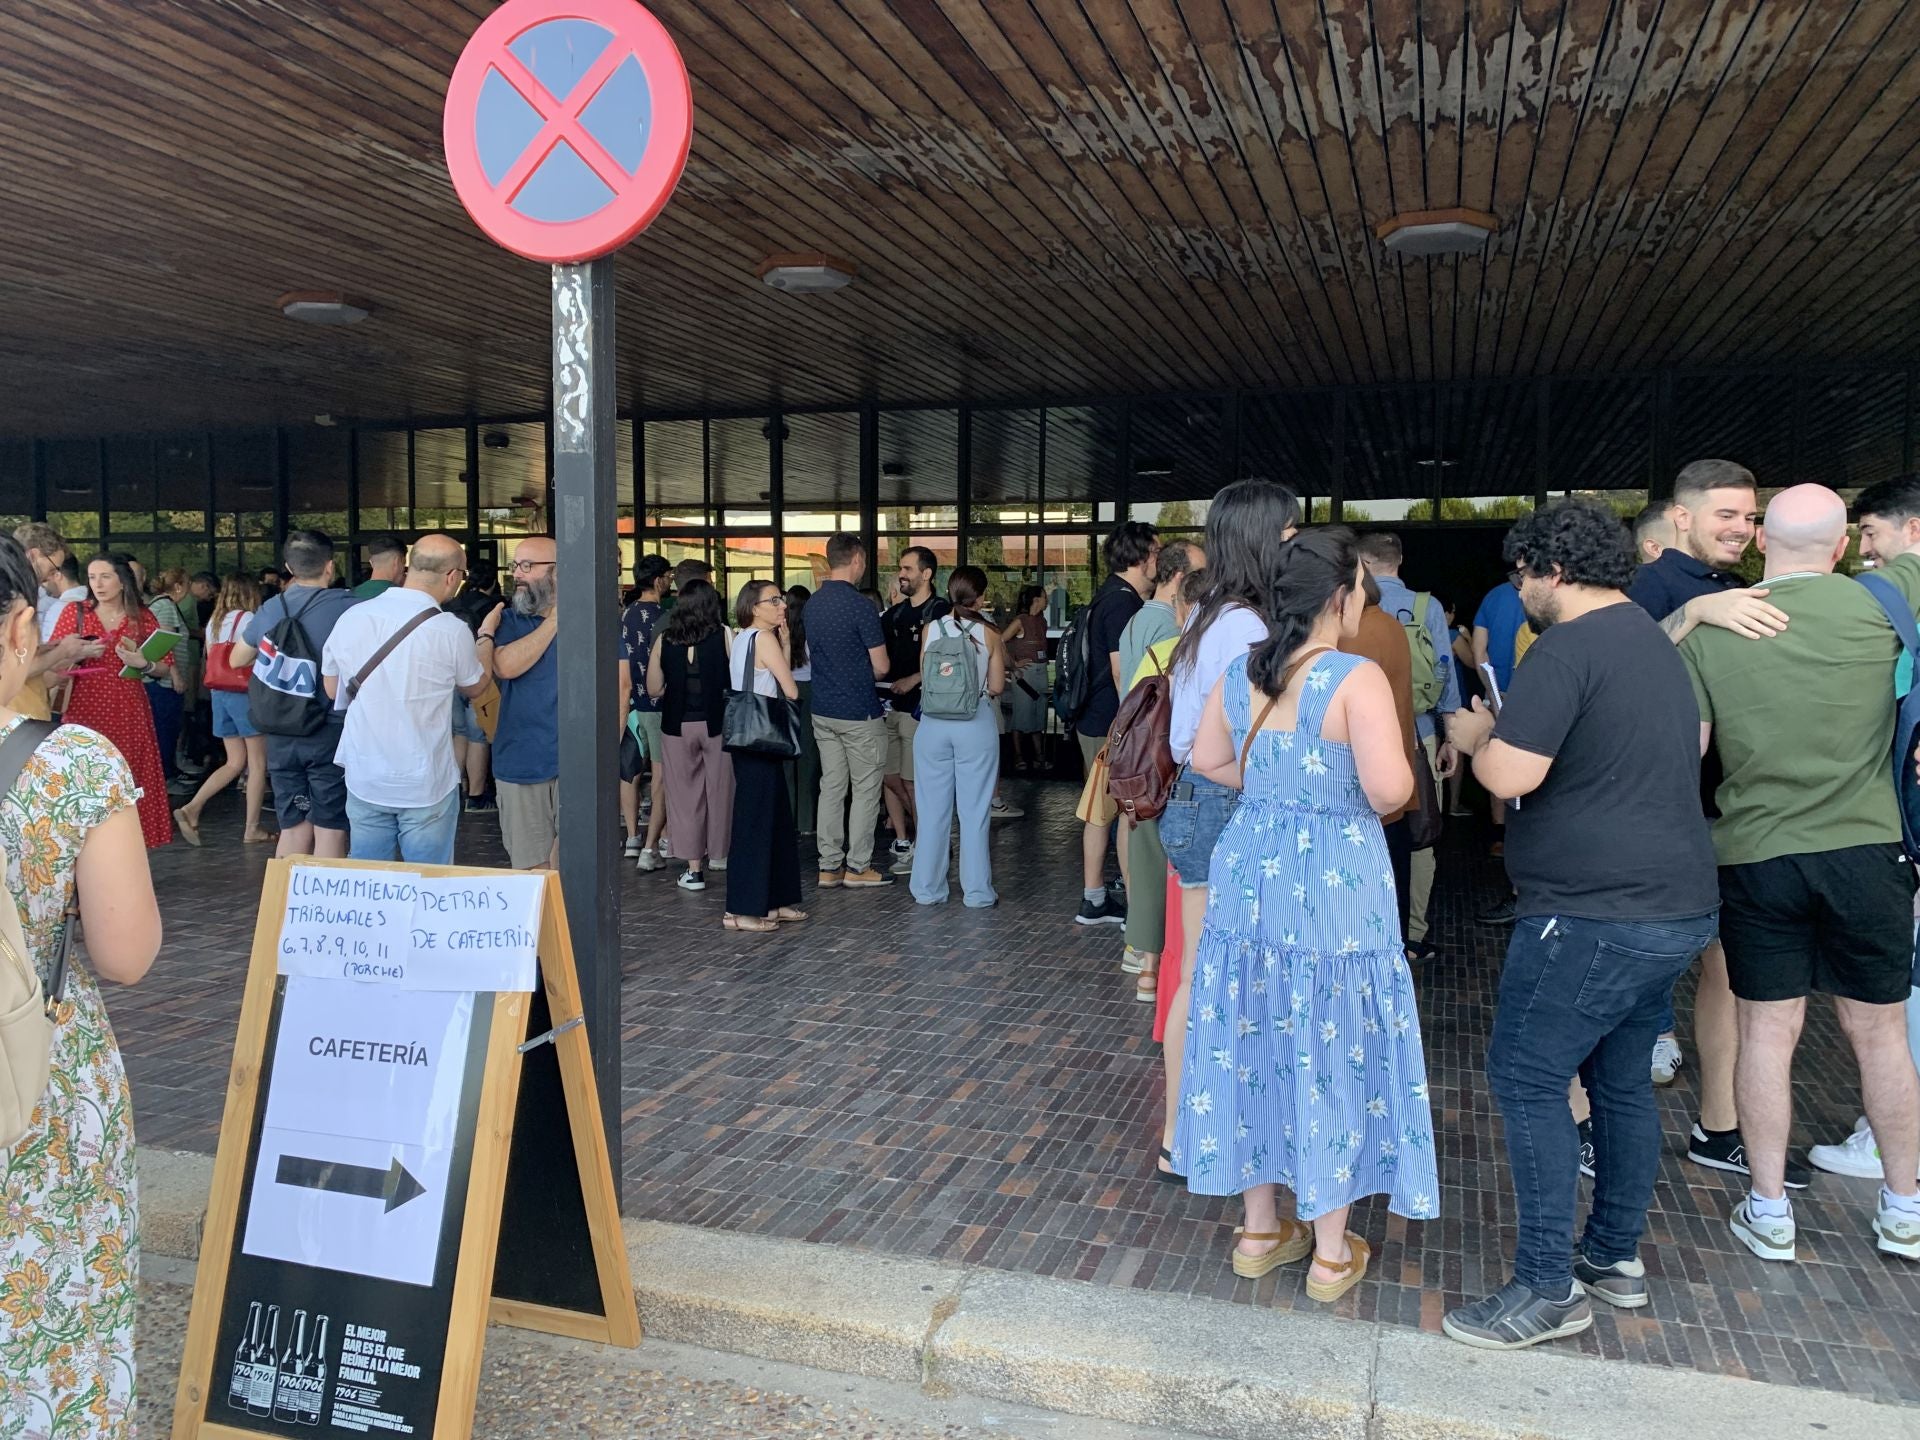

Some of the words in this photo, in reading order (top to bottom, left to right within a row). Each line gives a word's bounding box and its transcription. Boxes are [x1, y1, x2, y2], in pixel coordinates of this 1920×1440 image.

[420, 886, 508, 912] DETRÁS
[410, 928, 438, 949] DE
[343, 961, 404, 979] (PORCHE)
[308, 1036, 429, 1067] CAFETERÍA
[345, 1323, 357, 1338] EL
[356, 1325, 387, 1343] MEJOR
[342, 1337, 363, 1354] BAR
[362, 1341, 375, 1356] ES
[374, 1343, 386, 1358] EL
[386, 1346, 406, 1361] QUE
[338, 1366, 377, 1386] FAMILIA.
[340, 1351, 371, 1370] REÚNE
[369, 1357, 377, 1371] A
[377, 1358, 390, 1374] LA
[389, 1361, 421, 1380] MEJOR
[335, 1386, 358, 1400] 1906
